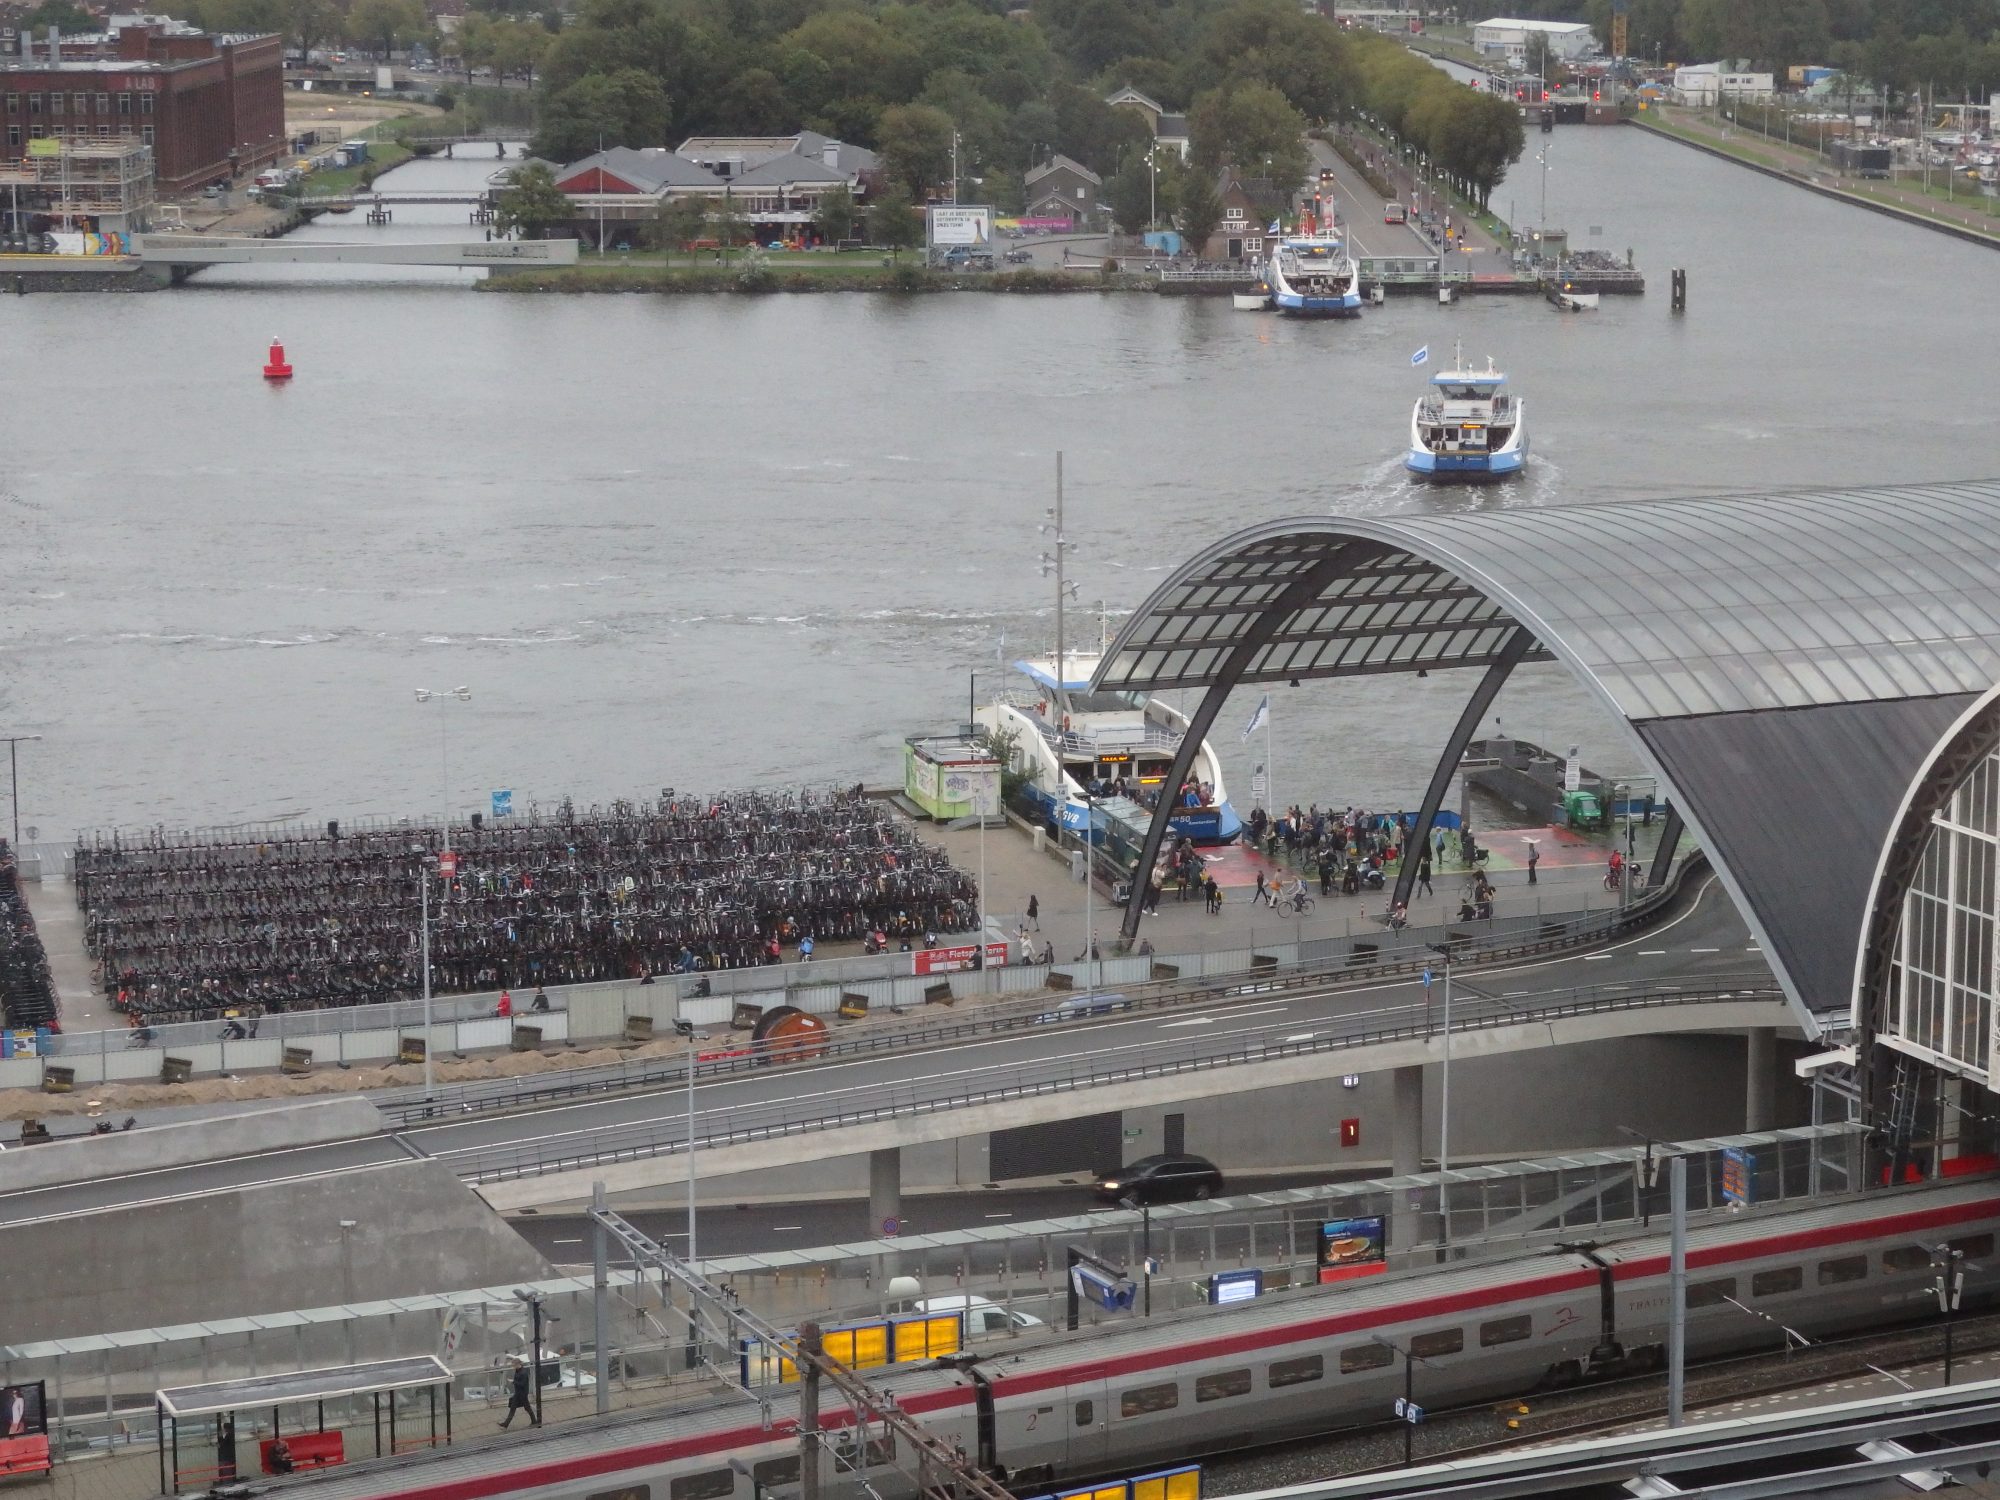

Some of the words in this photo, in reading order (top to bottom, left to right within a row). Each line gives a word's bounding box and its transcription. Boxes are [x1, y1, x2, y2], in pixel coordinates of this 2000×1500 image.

[125, 76, 132, 91] A
[135, 76, 155, 91] LAB
[1062, 810, 1080, 824] GVB
[1179, 815, 1191, 823] 50
[1026, 1413, 1038, 1432] 2
